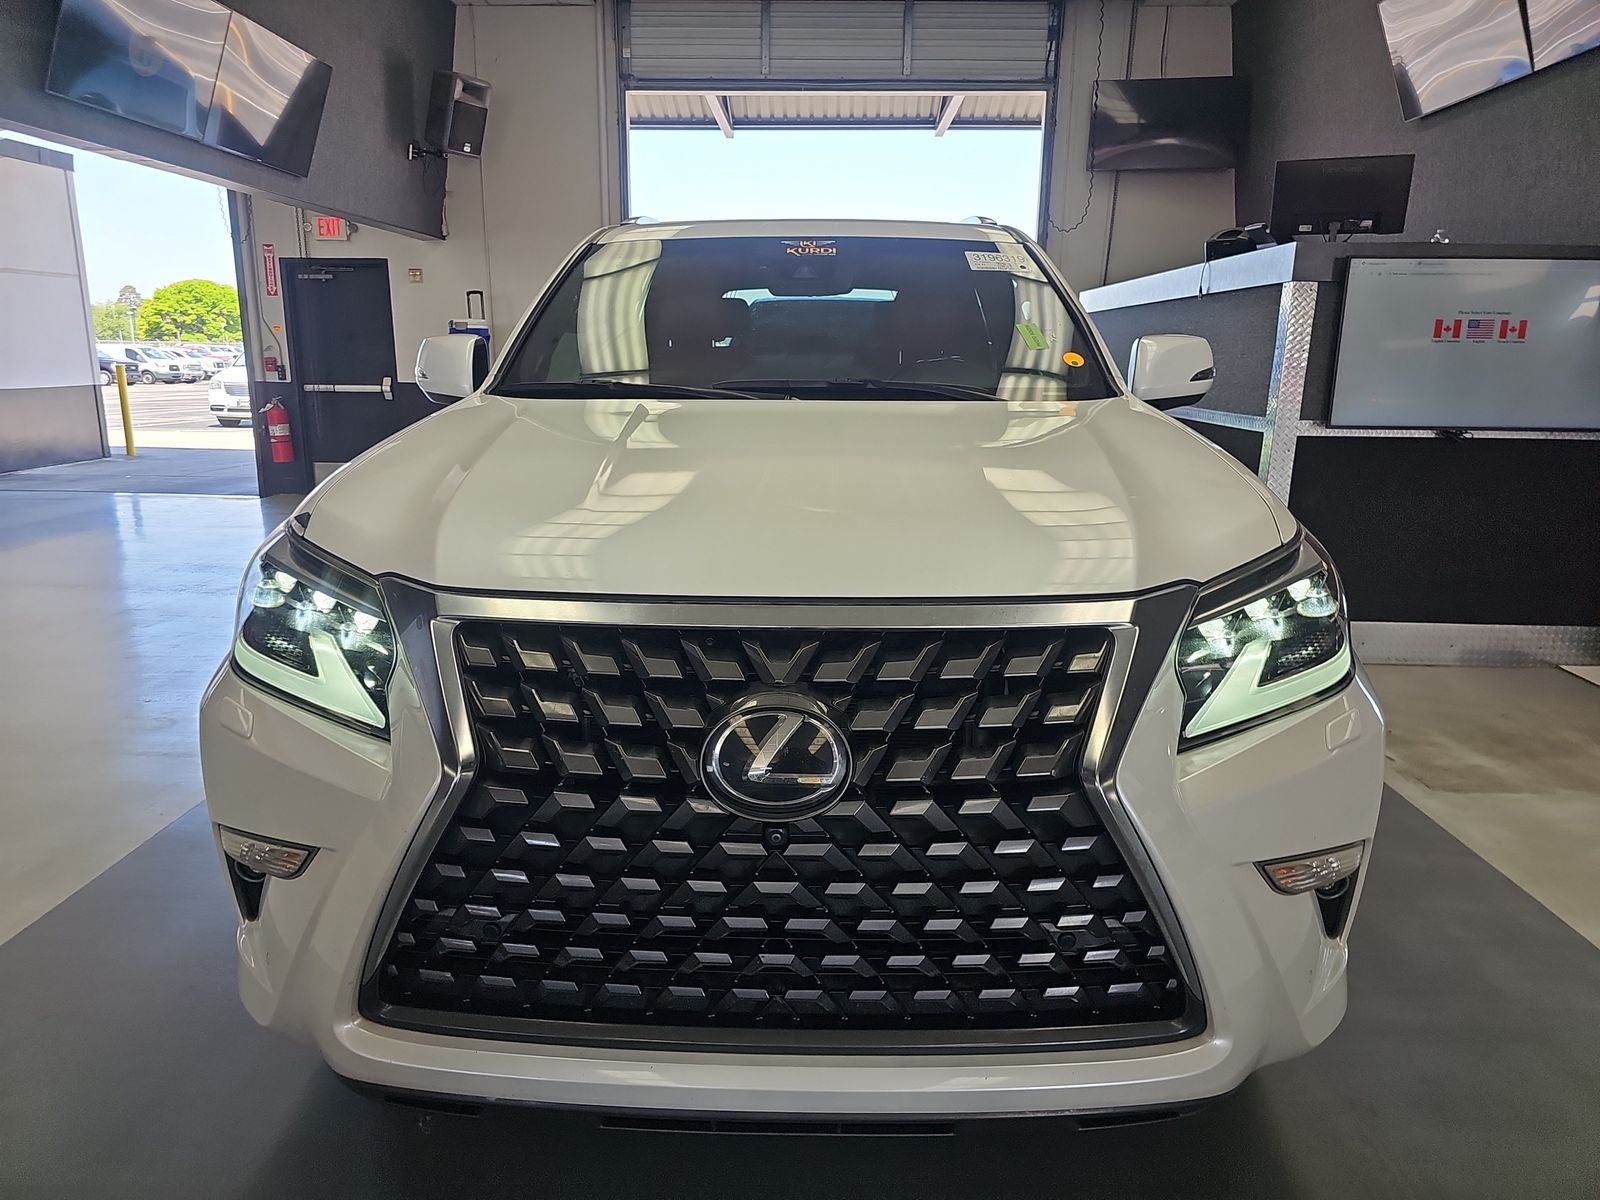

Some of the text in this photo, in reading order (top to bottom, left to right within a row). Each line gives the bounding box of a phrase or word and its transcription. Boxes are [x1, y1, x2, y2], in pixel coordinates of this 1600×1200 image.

[318, 218, 340, 236] EXIT
[786, 247, 837, 256] KURDI
[972, 253, 1025, 263] 3196319
